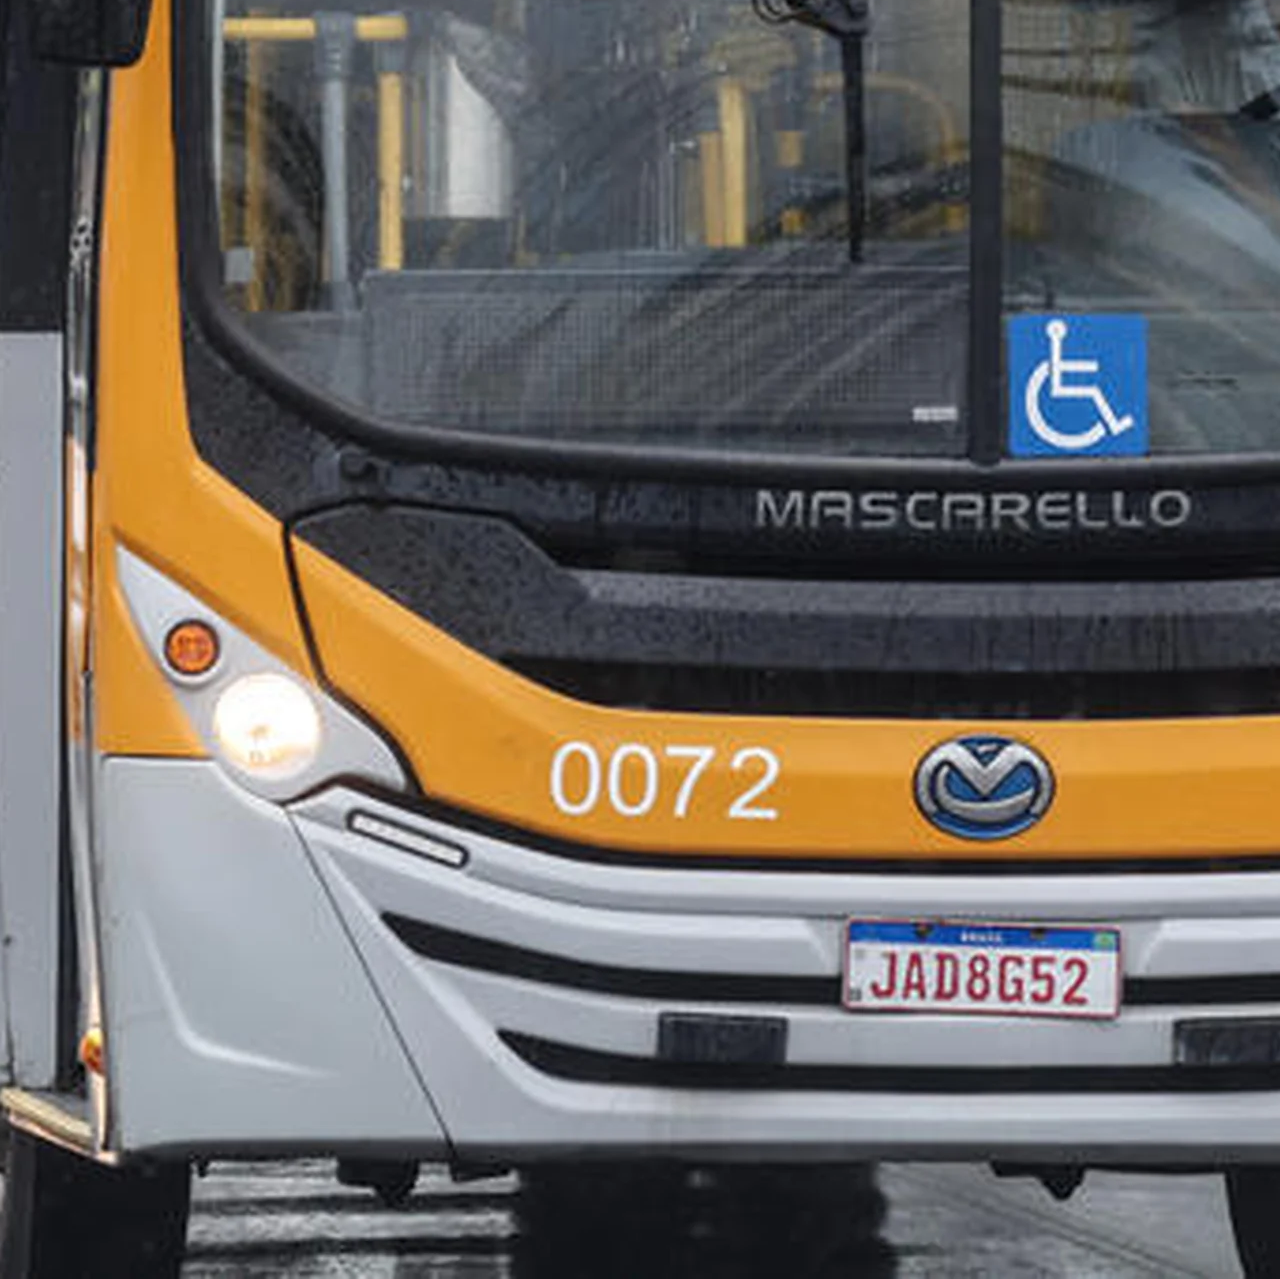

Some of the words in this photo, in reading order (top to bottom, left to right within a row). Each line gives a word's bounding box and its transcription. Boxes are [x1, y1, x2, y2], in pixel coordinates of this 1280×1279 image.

[756, 489, 1192, 530] MASCARELLO
[550, 740, 780, 819] 0072
[870, 951, 1089, 1005] JAD8G52
